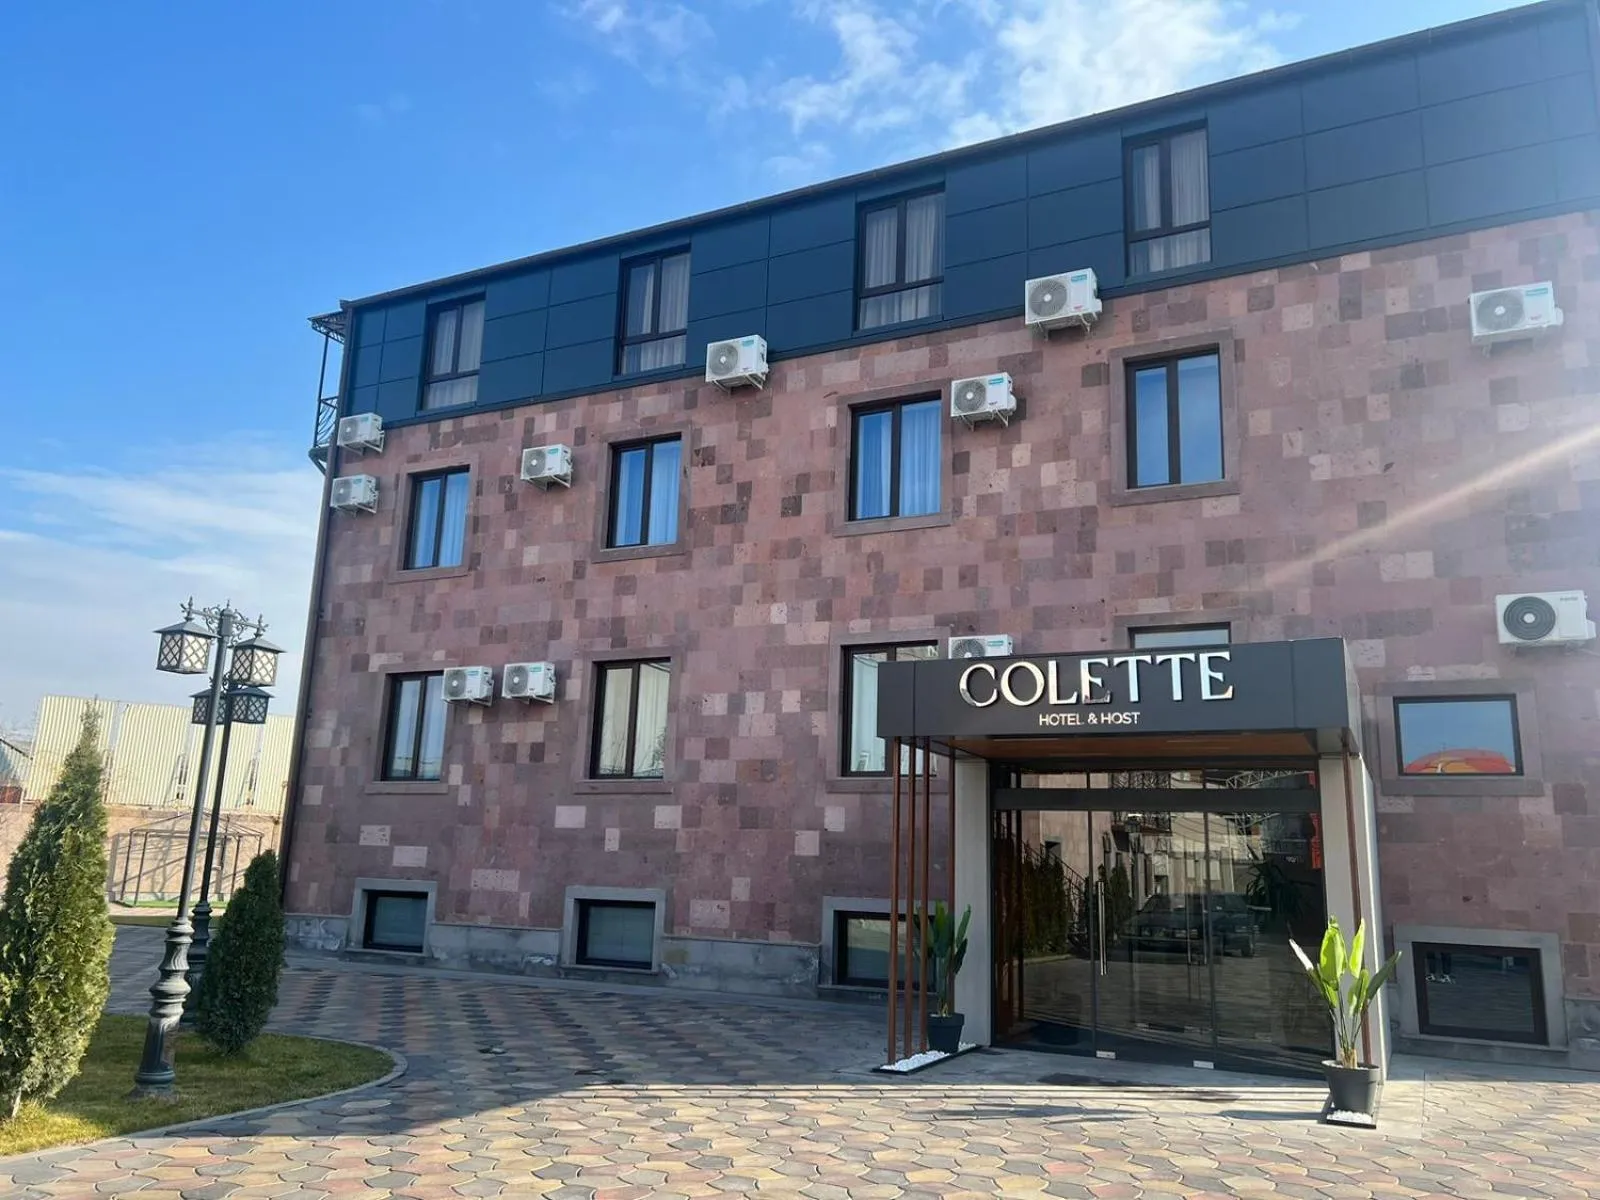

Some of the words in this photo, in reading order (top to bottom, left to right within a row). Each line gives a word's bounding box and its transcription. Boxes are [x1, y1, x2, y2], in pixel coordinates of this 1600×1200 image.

[959, 651, 1234, 707] COLETTE
[1039, 713, 1084, 726] HOTEL
[1087, 712, 1098, 724] &
[1100, 711, 1140, 724] HOST
